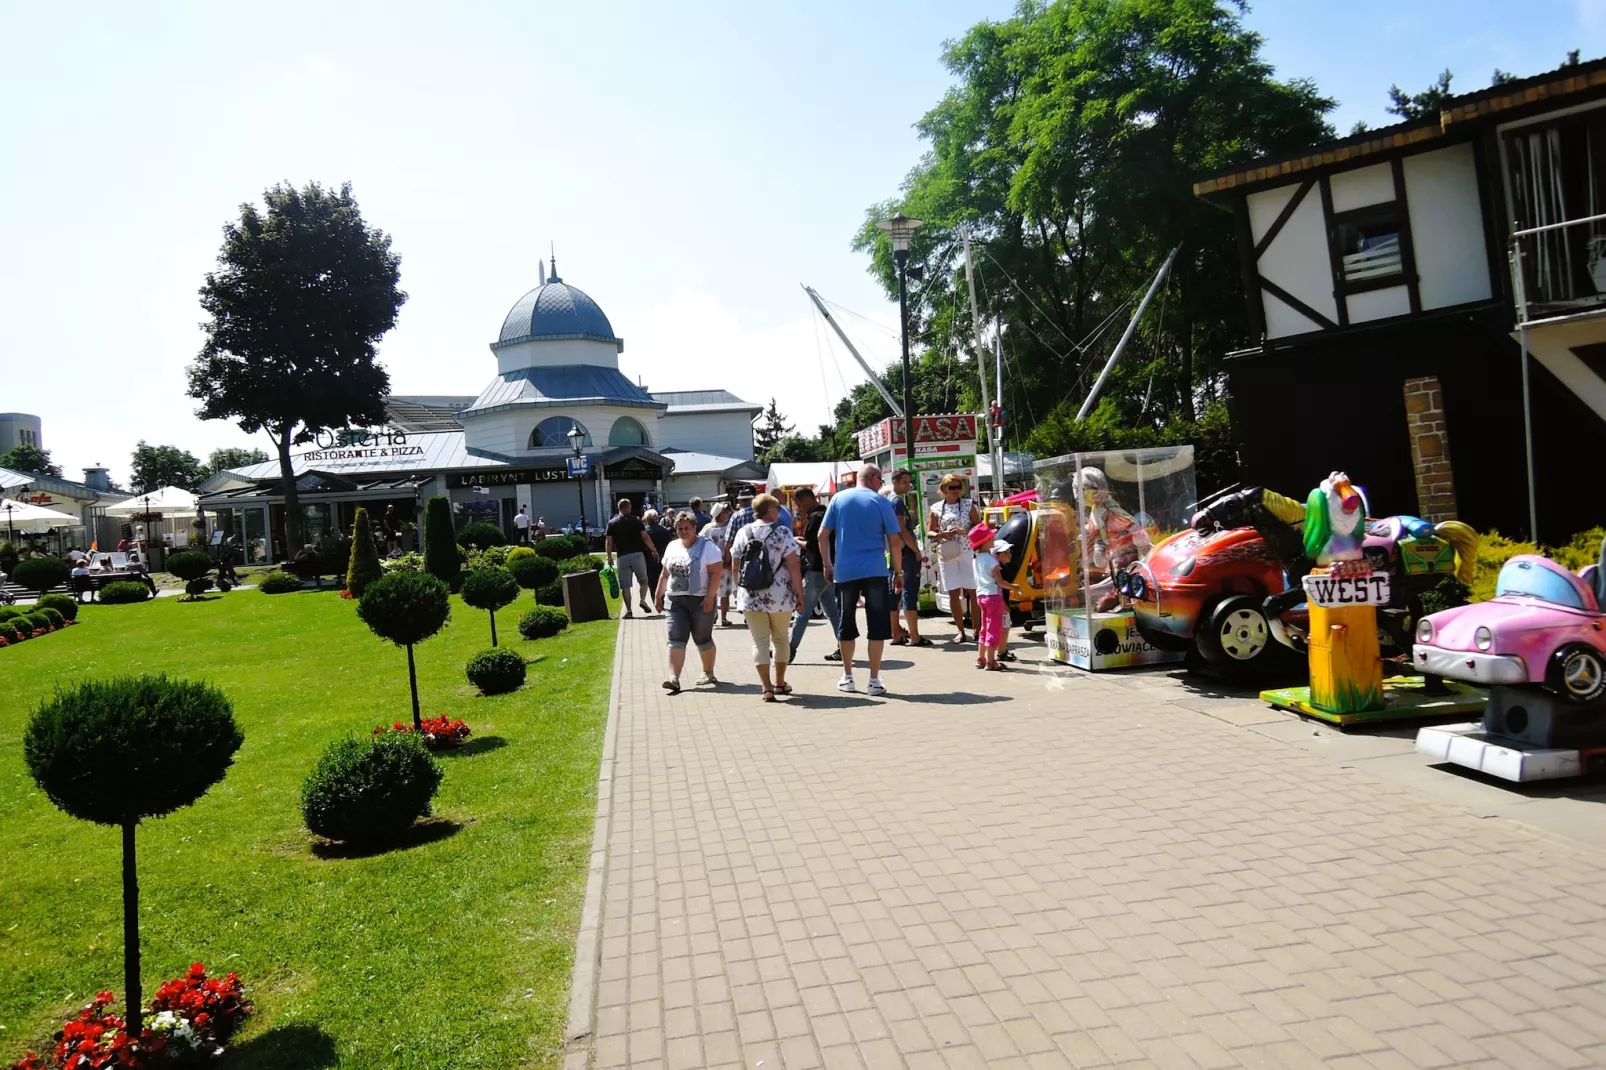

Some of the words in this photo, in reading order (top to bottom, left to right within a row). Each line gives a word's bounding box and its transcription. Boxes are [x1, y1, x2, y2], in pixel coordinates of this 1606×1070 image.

[893, 417, 974, 442] KASA
[316, 427, 407, 450] Osteria
[304, 449, 377, 461] RISTORANTE
[380, 447, 389, 457] &
[391, 445, 425, 457] PIZZA
[915, 446, 938, 454] KASA
[570, 457, 588, 469] WC
[461, 472, 526, 486] LABIRYNT
[534, 470, 567, 481] LUST
[1314, 576, 1386, 604] WEST
